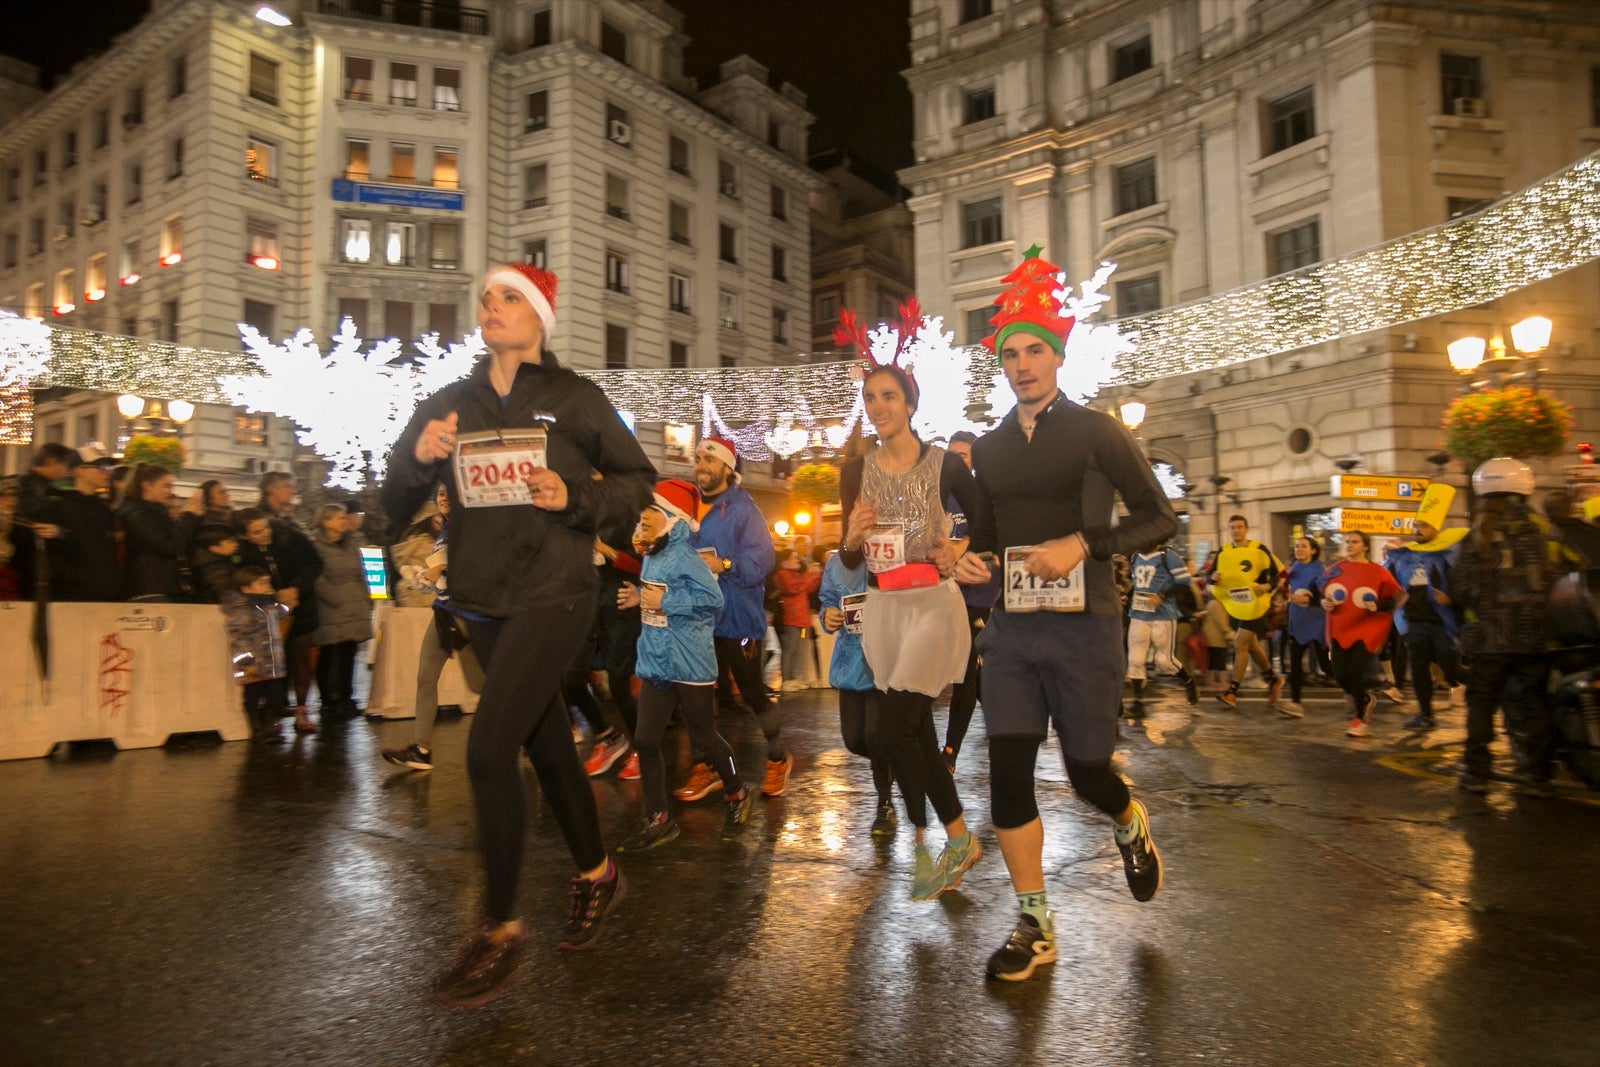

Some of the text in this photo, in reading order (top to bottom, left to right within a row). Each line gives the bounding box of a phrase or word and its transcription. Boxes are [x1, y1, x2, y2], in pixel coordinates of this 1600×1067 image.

[469, 460, 535, 488] 2049
[1363, 479, 1392, 488] Ganivet
[1354, 488, 1378, 496] centro
[1398, 482, 1409, 496] P
[1341, 511, 1385, 521] Oficina de
[1341, 520, 1375, 530] Turismo
[1135, 565, 1157, 589] 87
